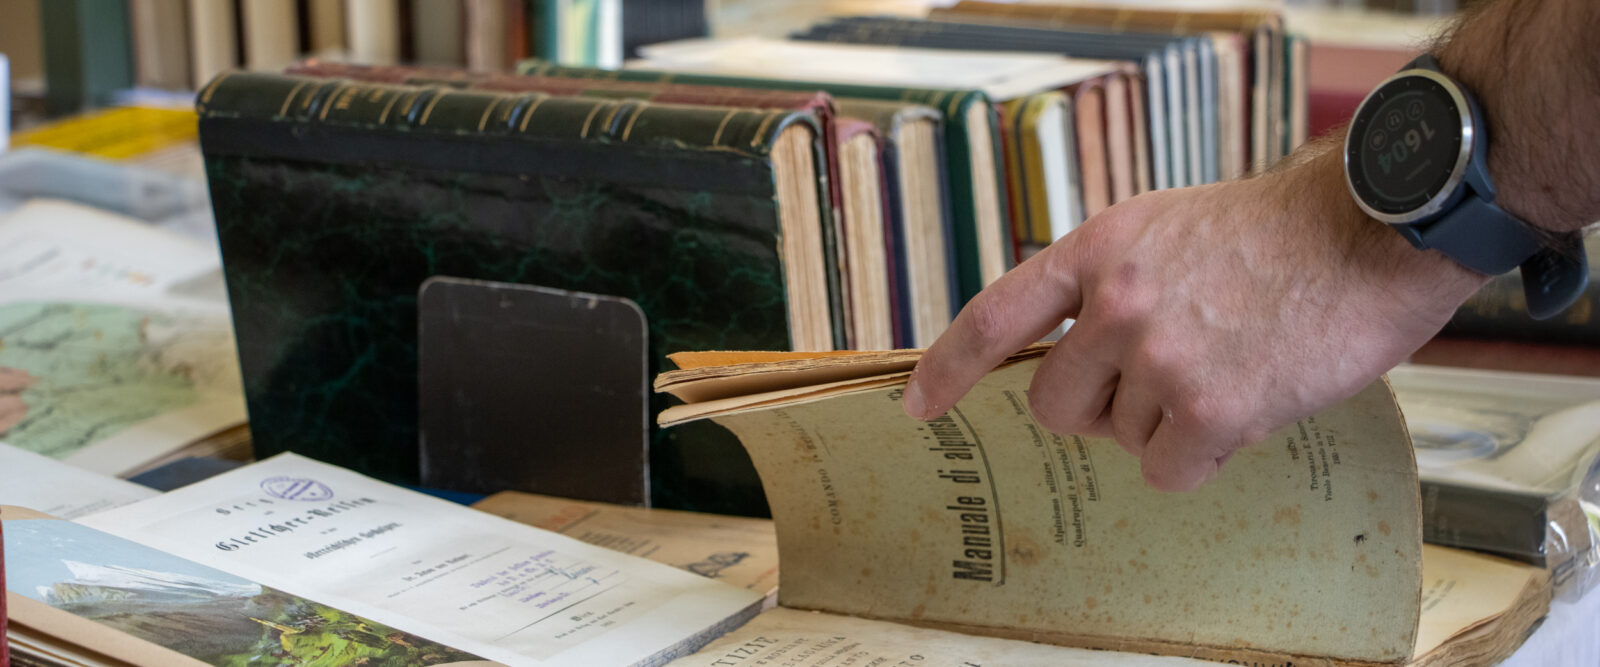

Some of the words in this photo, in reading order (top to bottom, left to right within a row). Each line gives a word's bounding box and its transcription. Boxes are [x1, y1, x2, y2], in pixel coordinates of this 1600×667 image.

[1378, 120, 1435, 175] 1604
[917, 411, 977, 461] alpinism
[936, 469, 981, 485] di
[1044, 462, 1057, 494] militare
[1056, 448, 1074, 483] materiali
[1080, 463, 1091, 473] di
[1085, 475, 1097, 502] Indice
[817, 468, 842, 526] COMANDO
[1067, 493, 1083, 548] Quadrupedi
[946, 496, 993, 582] Manuale
[1052, 498, 1067, 545] Alpinismo
